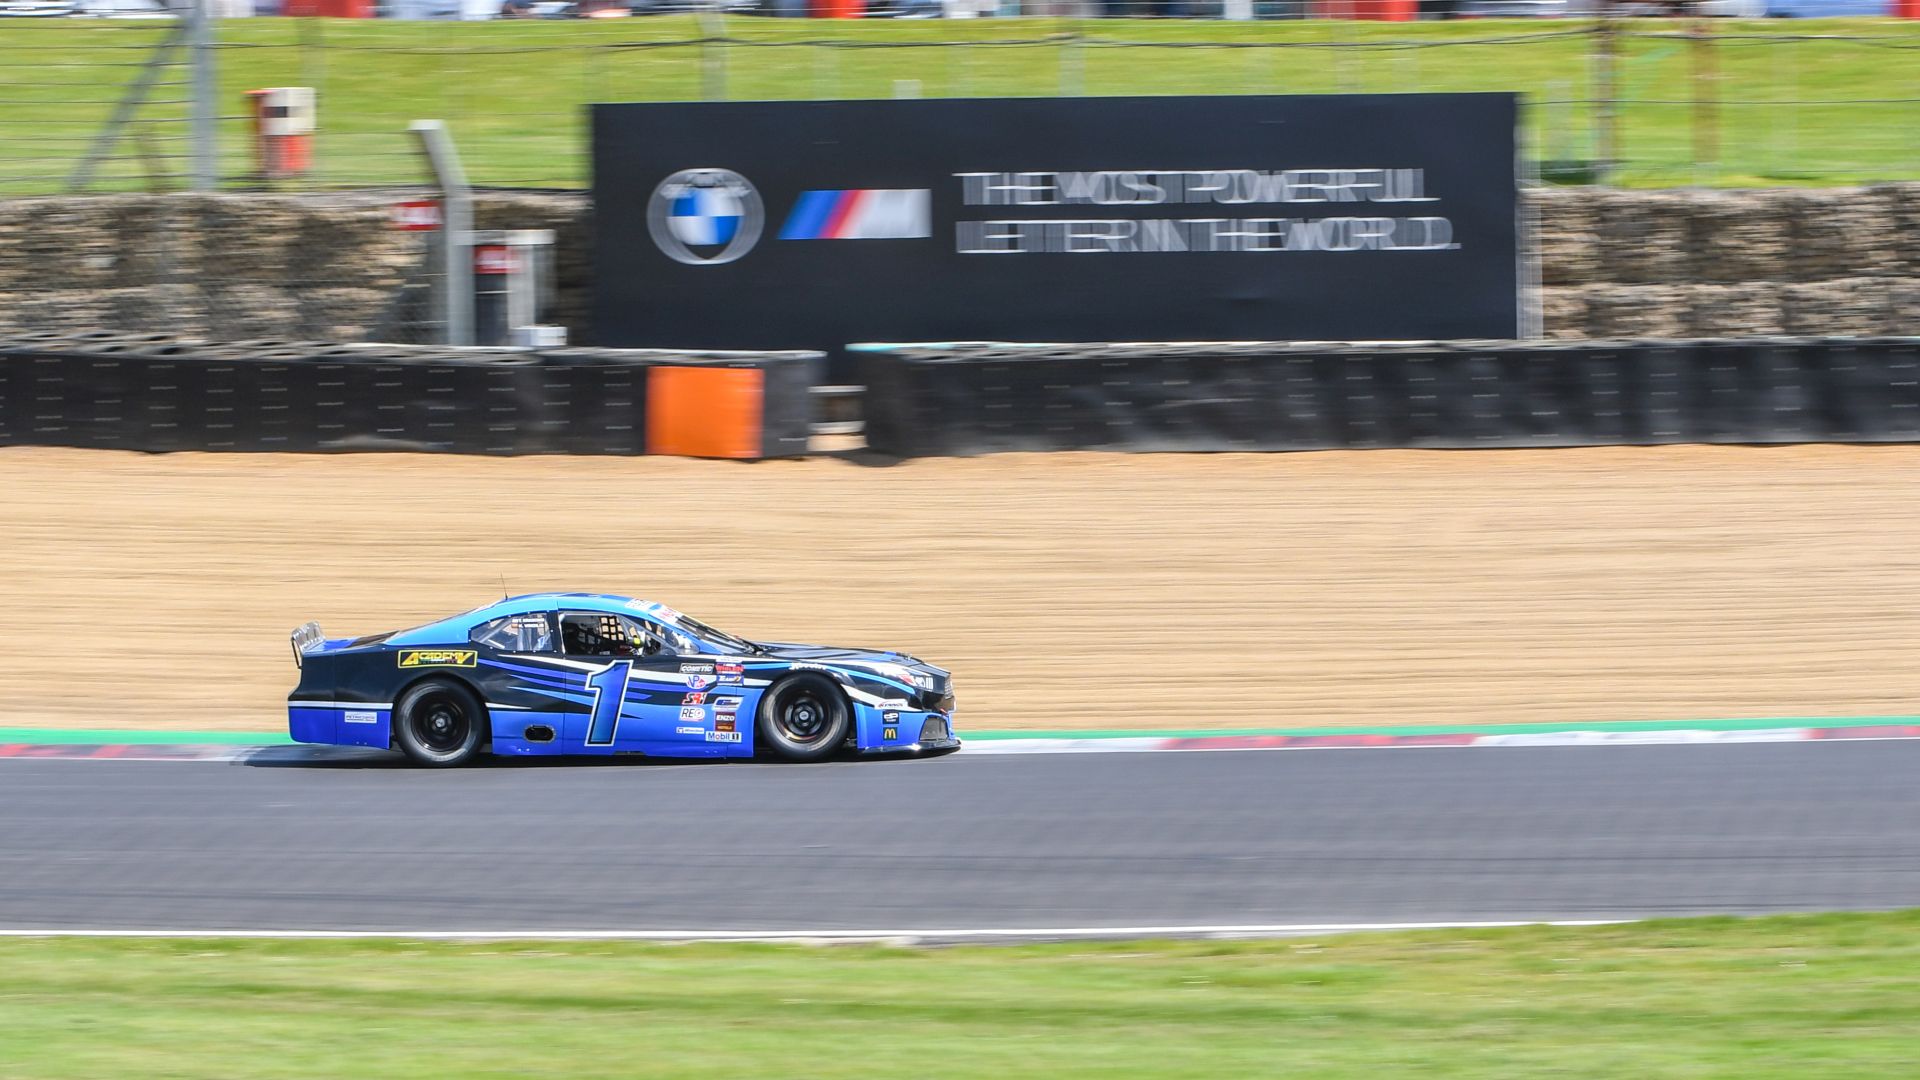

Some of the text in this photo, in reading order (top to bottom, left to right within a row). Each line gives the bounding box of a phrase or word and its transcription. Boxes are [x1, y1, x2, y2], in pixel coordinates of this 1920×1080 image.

[953, 169, 1441, 205] THE MOST POWERFUL
[955, 219, 1140, 253] LETTER
[1179, 218, 1288, 252] THE
[584, 659, 634, 747] 1
[707, 732, 730, 740] Mobil
